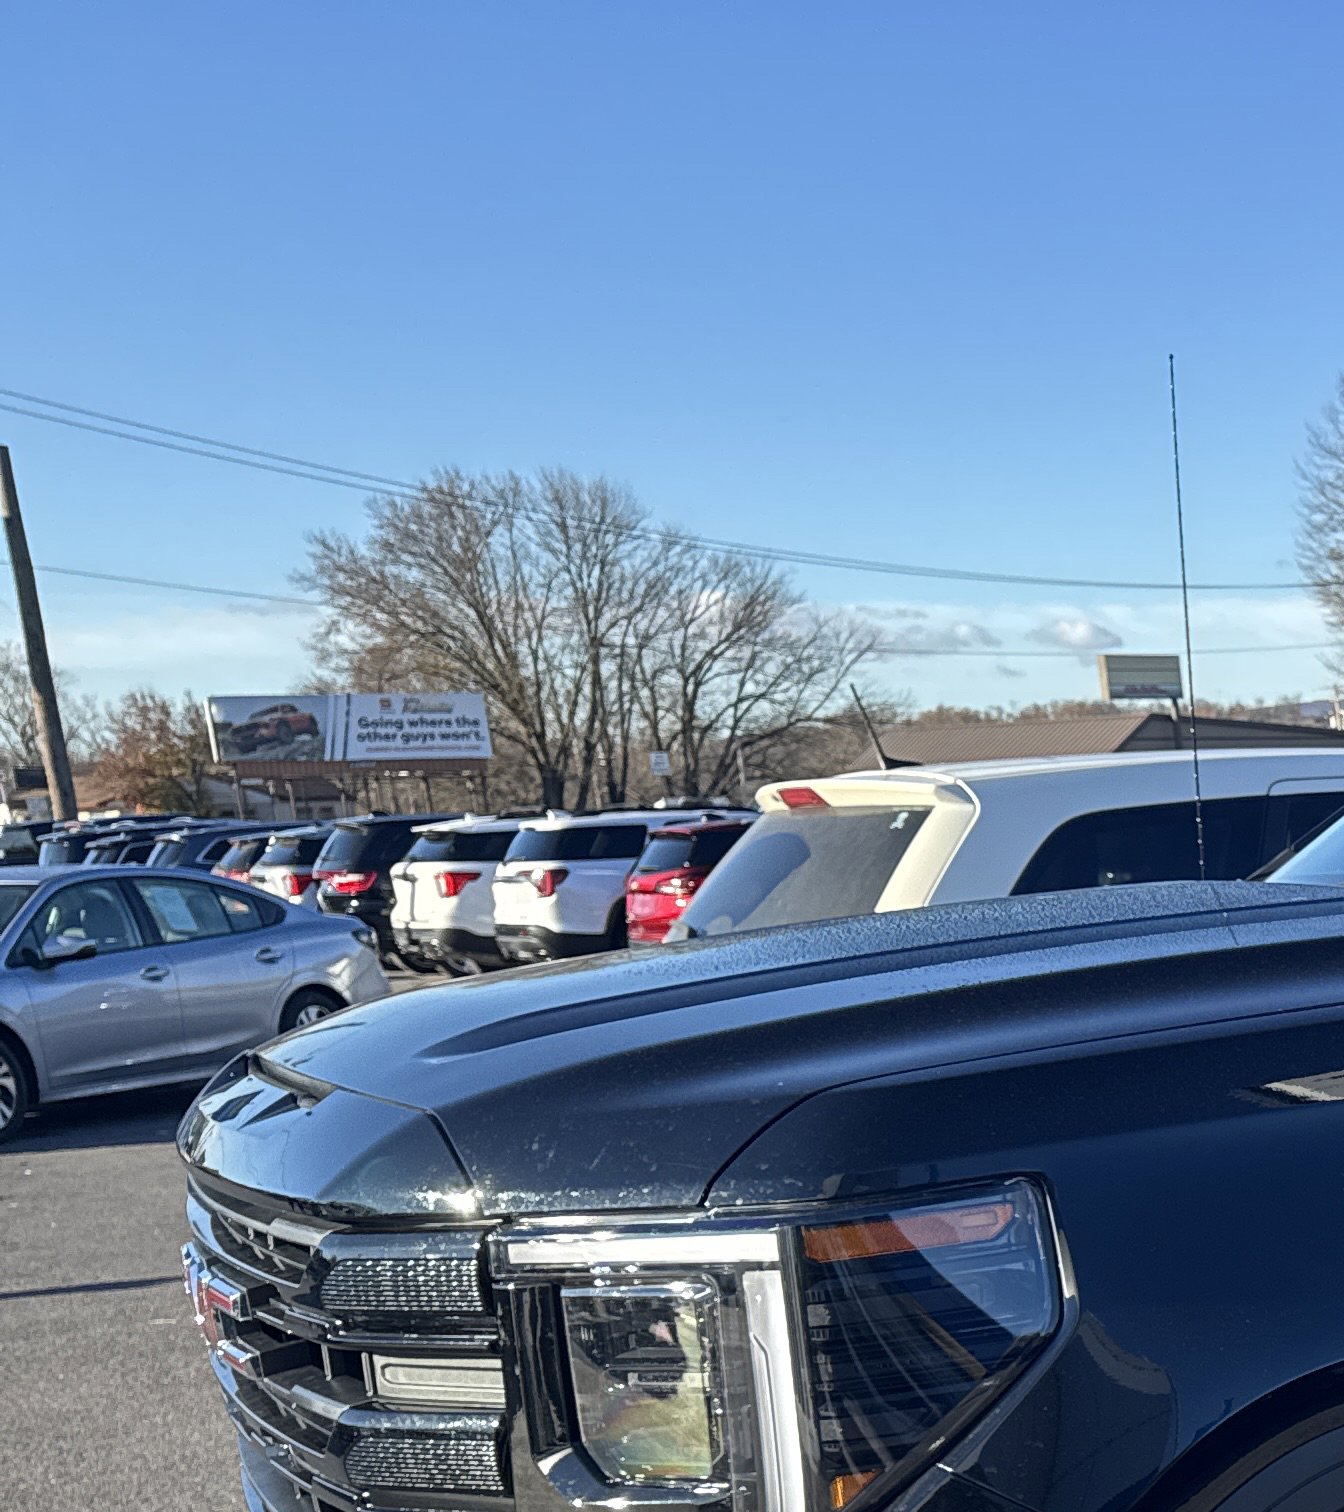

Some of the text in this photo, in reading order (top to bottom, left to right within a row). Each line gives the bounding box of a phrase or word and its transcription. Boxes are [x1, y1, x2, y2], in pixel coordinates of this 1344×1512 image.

[358, 716, 481, 731] Going where the
[357, 732, 397, 742] other
[400, 732, 436, 744] guys
